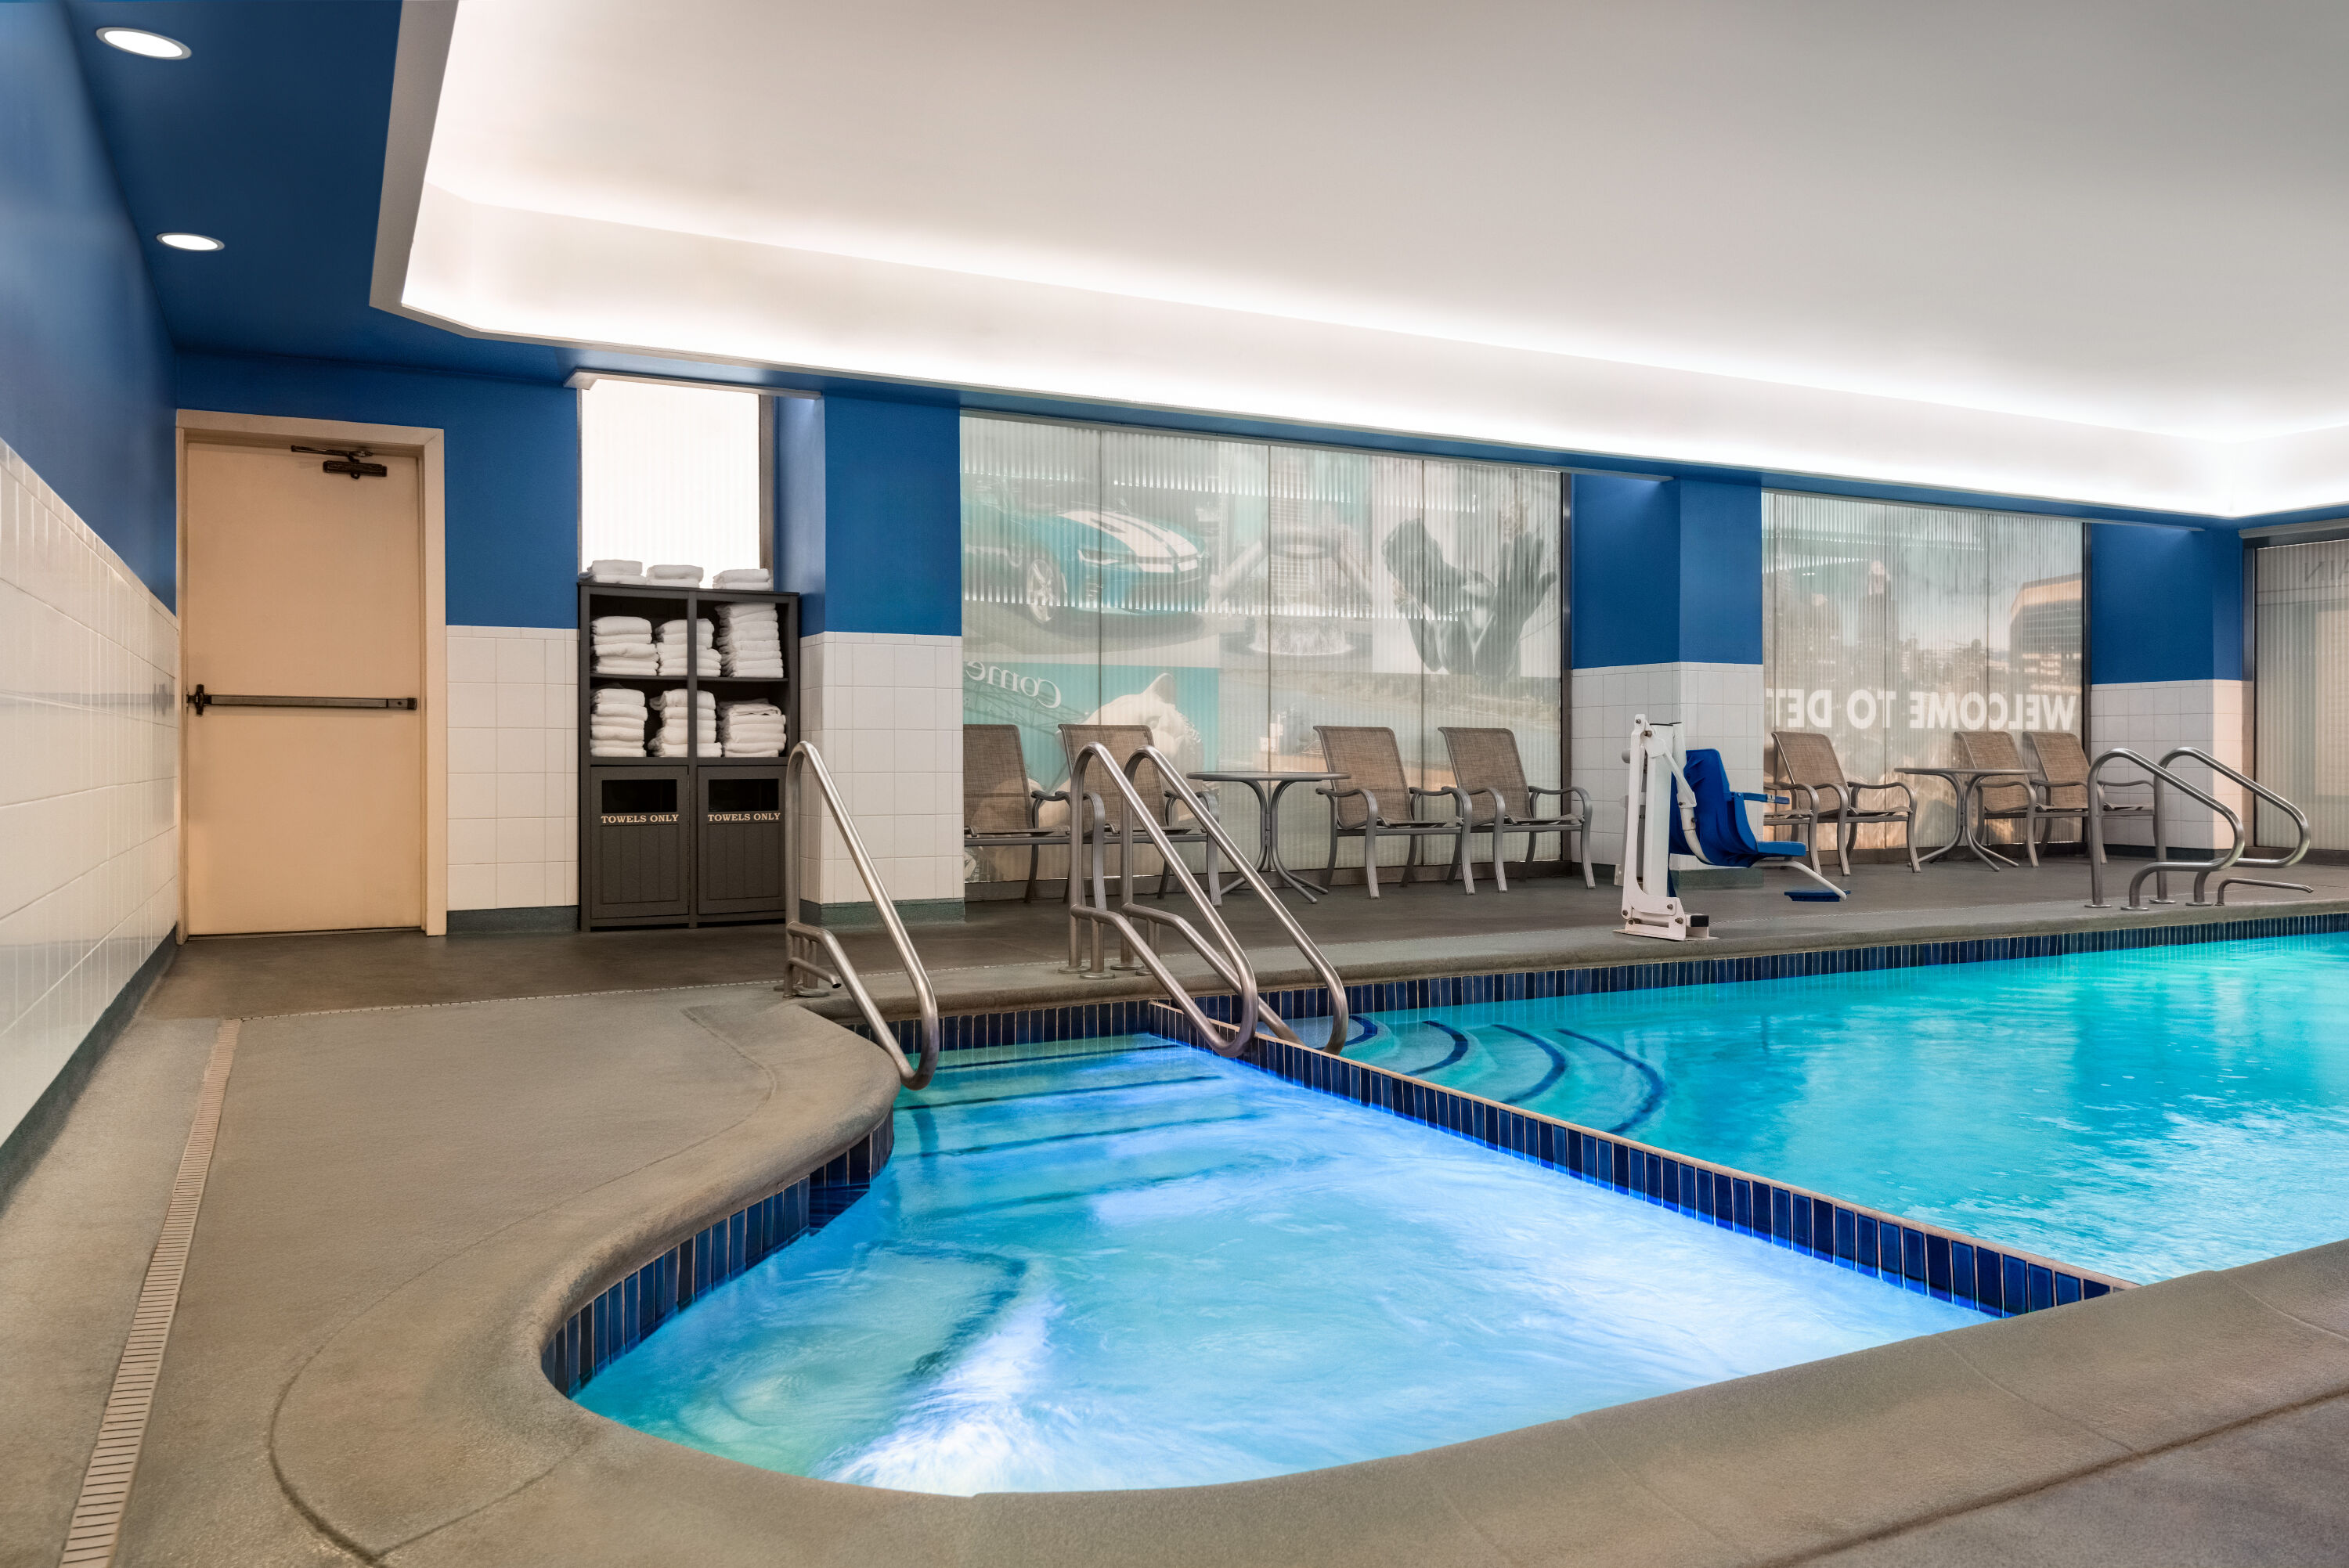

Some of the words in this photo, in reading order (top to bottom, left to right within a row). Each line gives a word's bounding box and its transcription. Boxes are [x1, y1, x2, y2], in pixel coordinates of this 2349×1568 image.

[601, 815, 647, 824] TOWELS
[708, 813, 751, 822] TOWELS
[753, 813, 781, 821] ONLY
